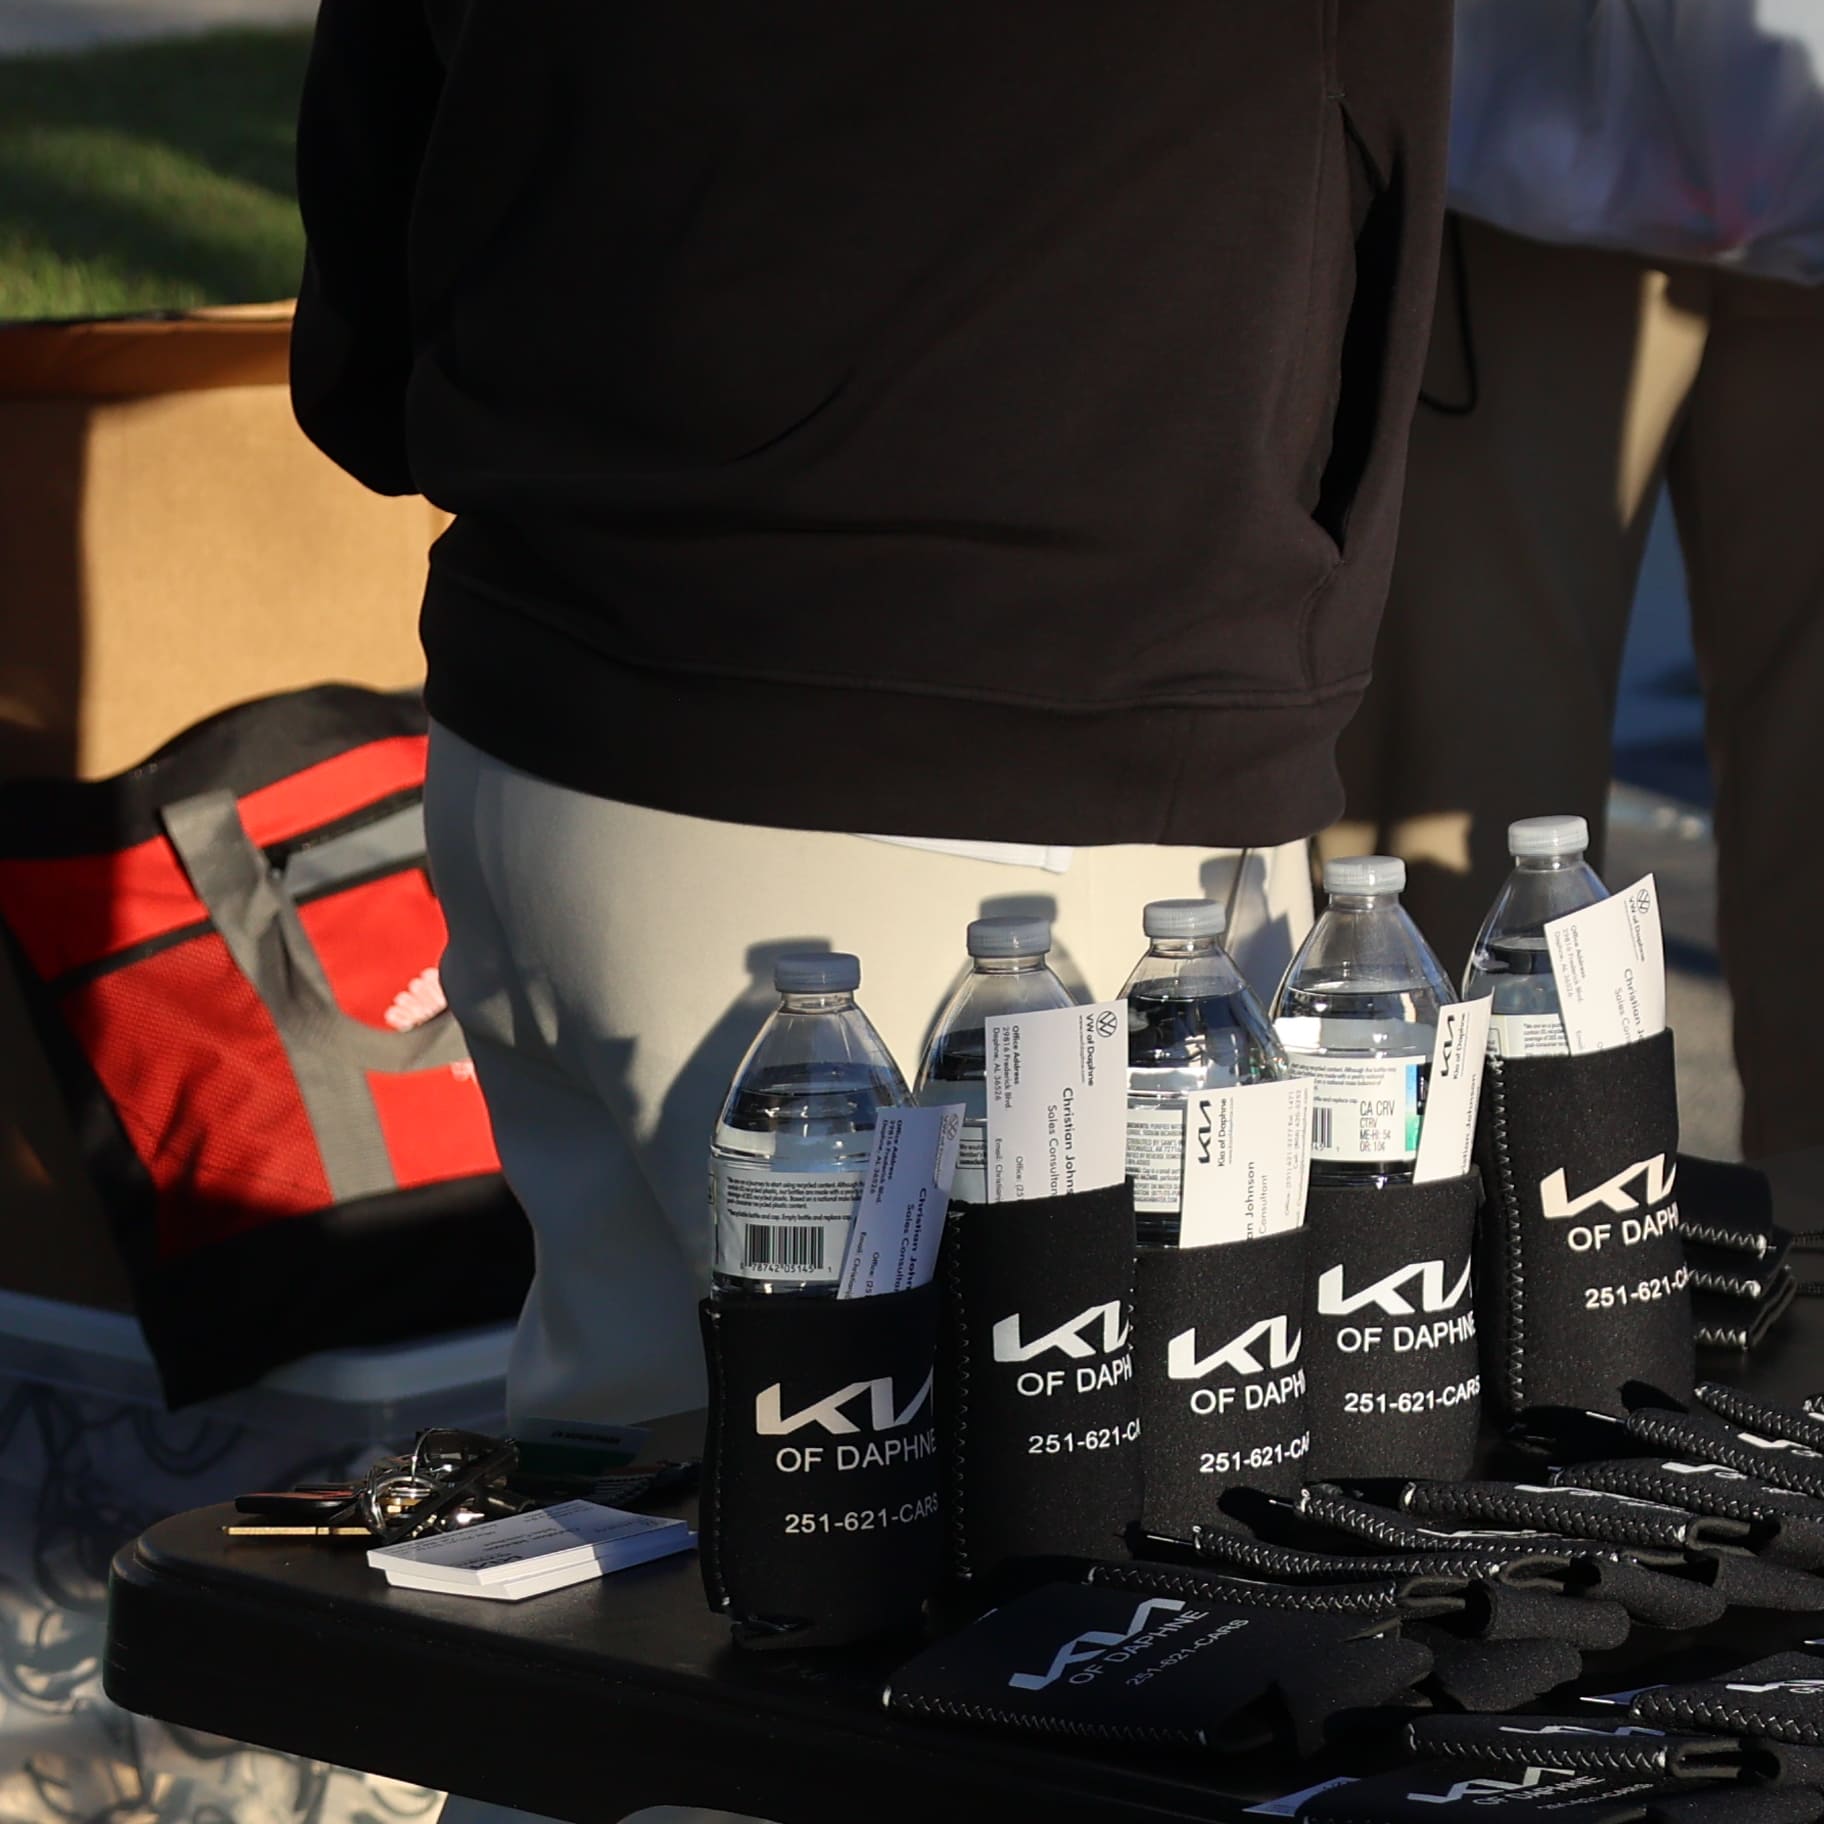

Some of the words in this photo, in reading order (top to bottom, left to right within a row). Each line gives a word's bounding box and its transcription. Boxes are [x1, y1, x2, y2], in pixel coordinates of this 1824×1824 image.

[1624, 968, 1641, 1026] Christian
[1012, 1025, 1020, 1050] Office
[1086, 1047, 1095, 1087] Daphne
[1047, 1104, 1058, 1135] Sales
[1062, 1087, 1075, 1151] Christian
[1218, 1098, 1227, 1136] Daphne
[1376, 1100, 1395, 1116] CRV
[1198, 1100, 1212, 1164] KIA
[1217, 1150, 1225, 1167] Kia
[1245, 1161, 1254, 1216] Johnson
[1258, 1175, 1268, 1234] Consultant
[903, 1204, 914, 1236] Sales
[912, 1188, 927, 1252] Christian
[1567, 1223, 1612, 1252] OF
[993, 1299, 1130, 1363] KI
[1337, 1327, 1383, 1353] OF
[1017, 1371, 1066, 1397] OF
[1076, 1353, 1133, 1393] DAPH
[1344, 1374, 1481, 1414] 251-621-CARS
[1190, 1387, 1237, 1415] OF
[776, 1447, 824, 1473] OF
[836, 1427, 937, 1471] DAPHNE
[784, 1492, 939, 1534] 251-621-CARS
[1008, 1597, 1187, 1691] KIA
[1069, 1663, 1104, 1685] OF
[1103, 1609, 1210, 1663] DAPHNE
